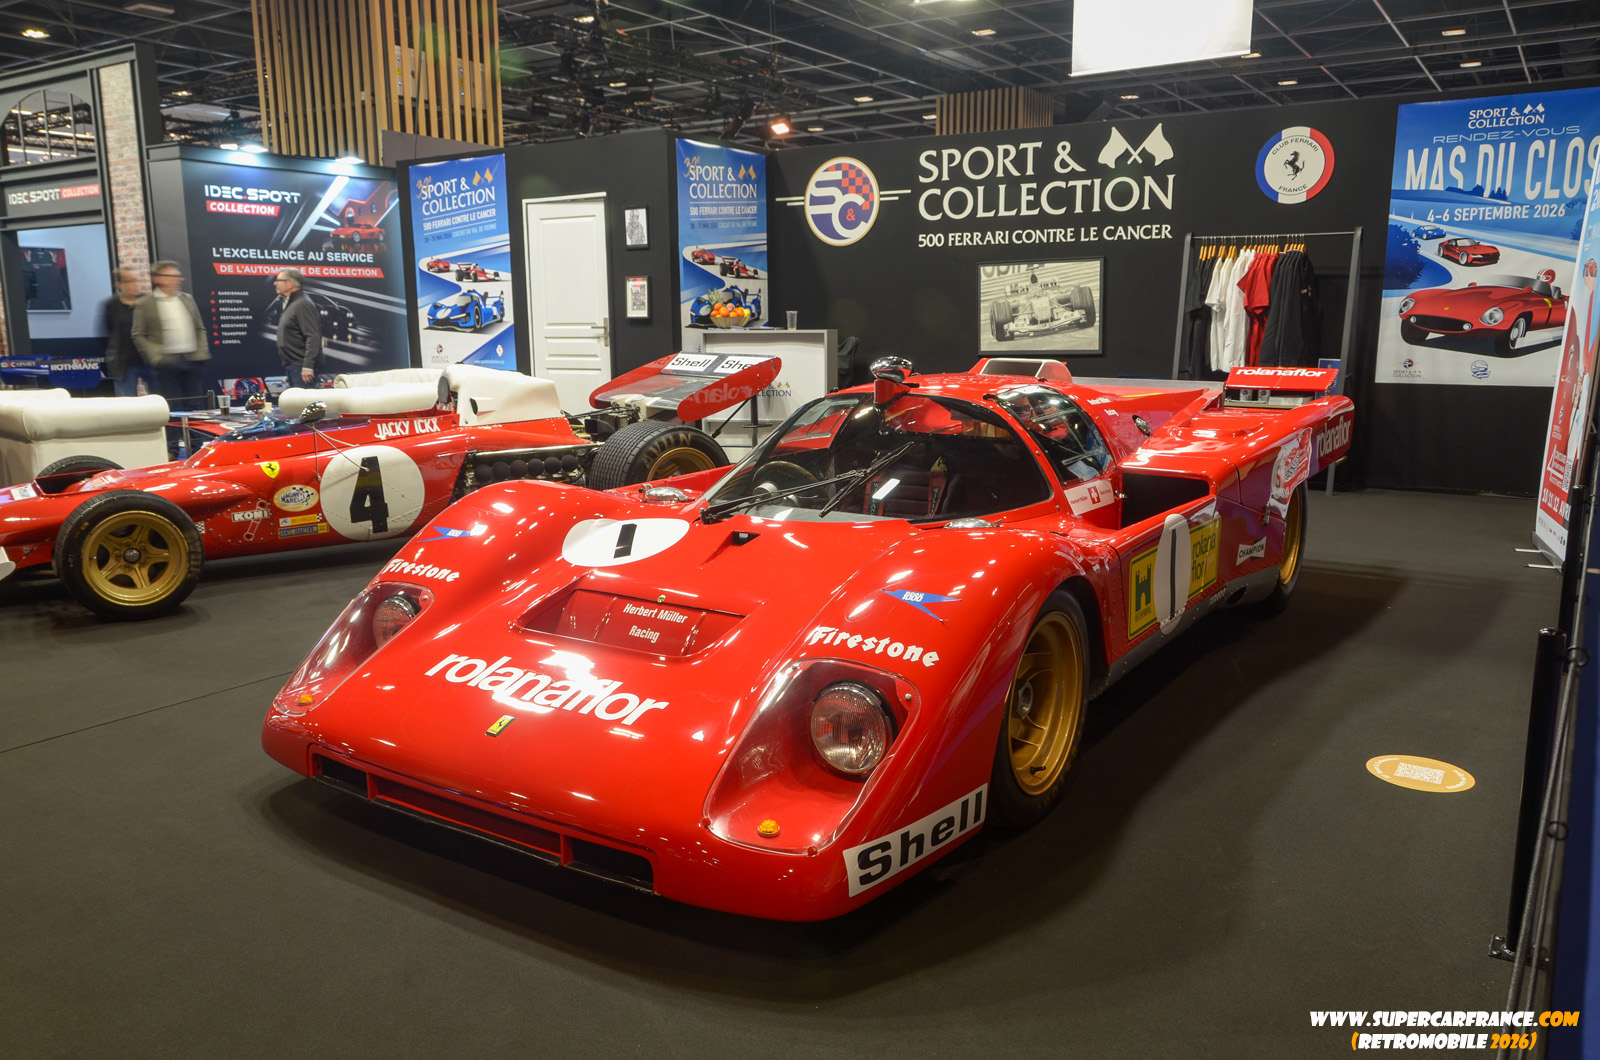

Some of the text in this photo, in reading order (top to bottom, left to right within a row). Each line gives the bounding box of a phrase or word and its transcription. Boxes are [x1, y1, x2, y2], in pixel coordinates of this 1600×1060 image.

[1468, 114, 1545, 129] COLLECTION
[1469, 106, 1520, 120] SPORT &
[1433, 125, 1580, 144] RENDEZ-VOUS
[1272, 138, 1319, 155] CLUB FERRARI
[918, 141, 1087, 183] SPORT &
[1405, 145, 1467, 191] MAS
[1476, 142, 1516, 199] DU
[689, 165, 736, 181] SPORT &
[62, 185, 99, 198] COLLECTION
[421, 177, 470, 200] SPORT &
[689, 183, 757, 199] COLLECTION
[918, 174, 1177, 221] COLLECTION
[1278, 184, 1308, 193] FRANCE
[209, 202, 275, 215] COLLECTION
[422, 186, 495, 216] COLLECTION
[690, 205, 757, 216] 500 FERRARI CONTRE LE CANCER
[423, 208, 496, 231] 500 FERRARI CONTRE LE CANCER
[1454, 205, 1530, 221] SEPTEMBRE
[1534, 203, 1566, 218] 2026
[918, 224, 1173, 248] 500 FERRARI CONTRE LE CANCER
[212, 247, 374, 263] L'EXCELLENCE AU SERVICE
[220, 265, 378, 277] DE L'AUTOME DE COLLECTION
[50, 362, 99, 371] ROTHMANS
[671, 357, 711, 368] Shell
[720, 360, 755, 370] She
[1235, 367, 1328, 378] rolanaflor
[374, 417, 441, 440] JACKY ICKX
[1316, 415, 1351, 459] rolanaflor
[349, 455, 389, 534] 4
[232, 510, 270, 522] KONI
[613, 523, 638, 559] 1
[1239, 543, 1265, 558] CHAMPION
[381, 558, 460, 583] Firestone
[1169, 528, 1177, 620] 1
[1192, 559, 1205, 583] flor
[902, 594, 923, 602] 1000
[623, 603, 689, 624] Herbert Müller
[628, 625, 660, 644] Racing
[808, 625, 940, 667] Firestone
[424, 653, 671, 726] rolanaflor
[857, 790, 983, 886] Shell
